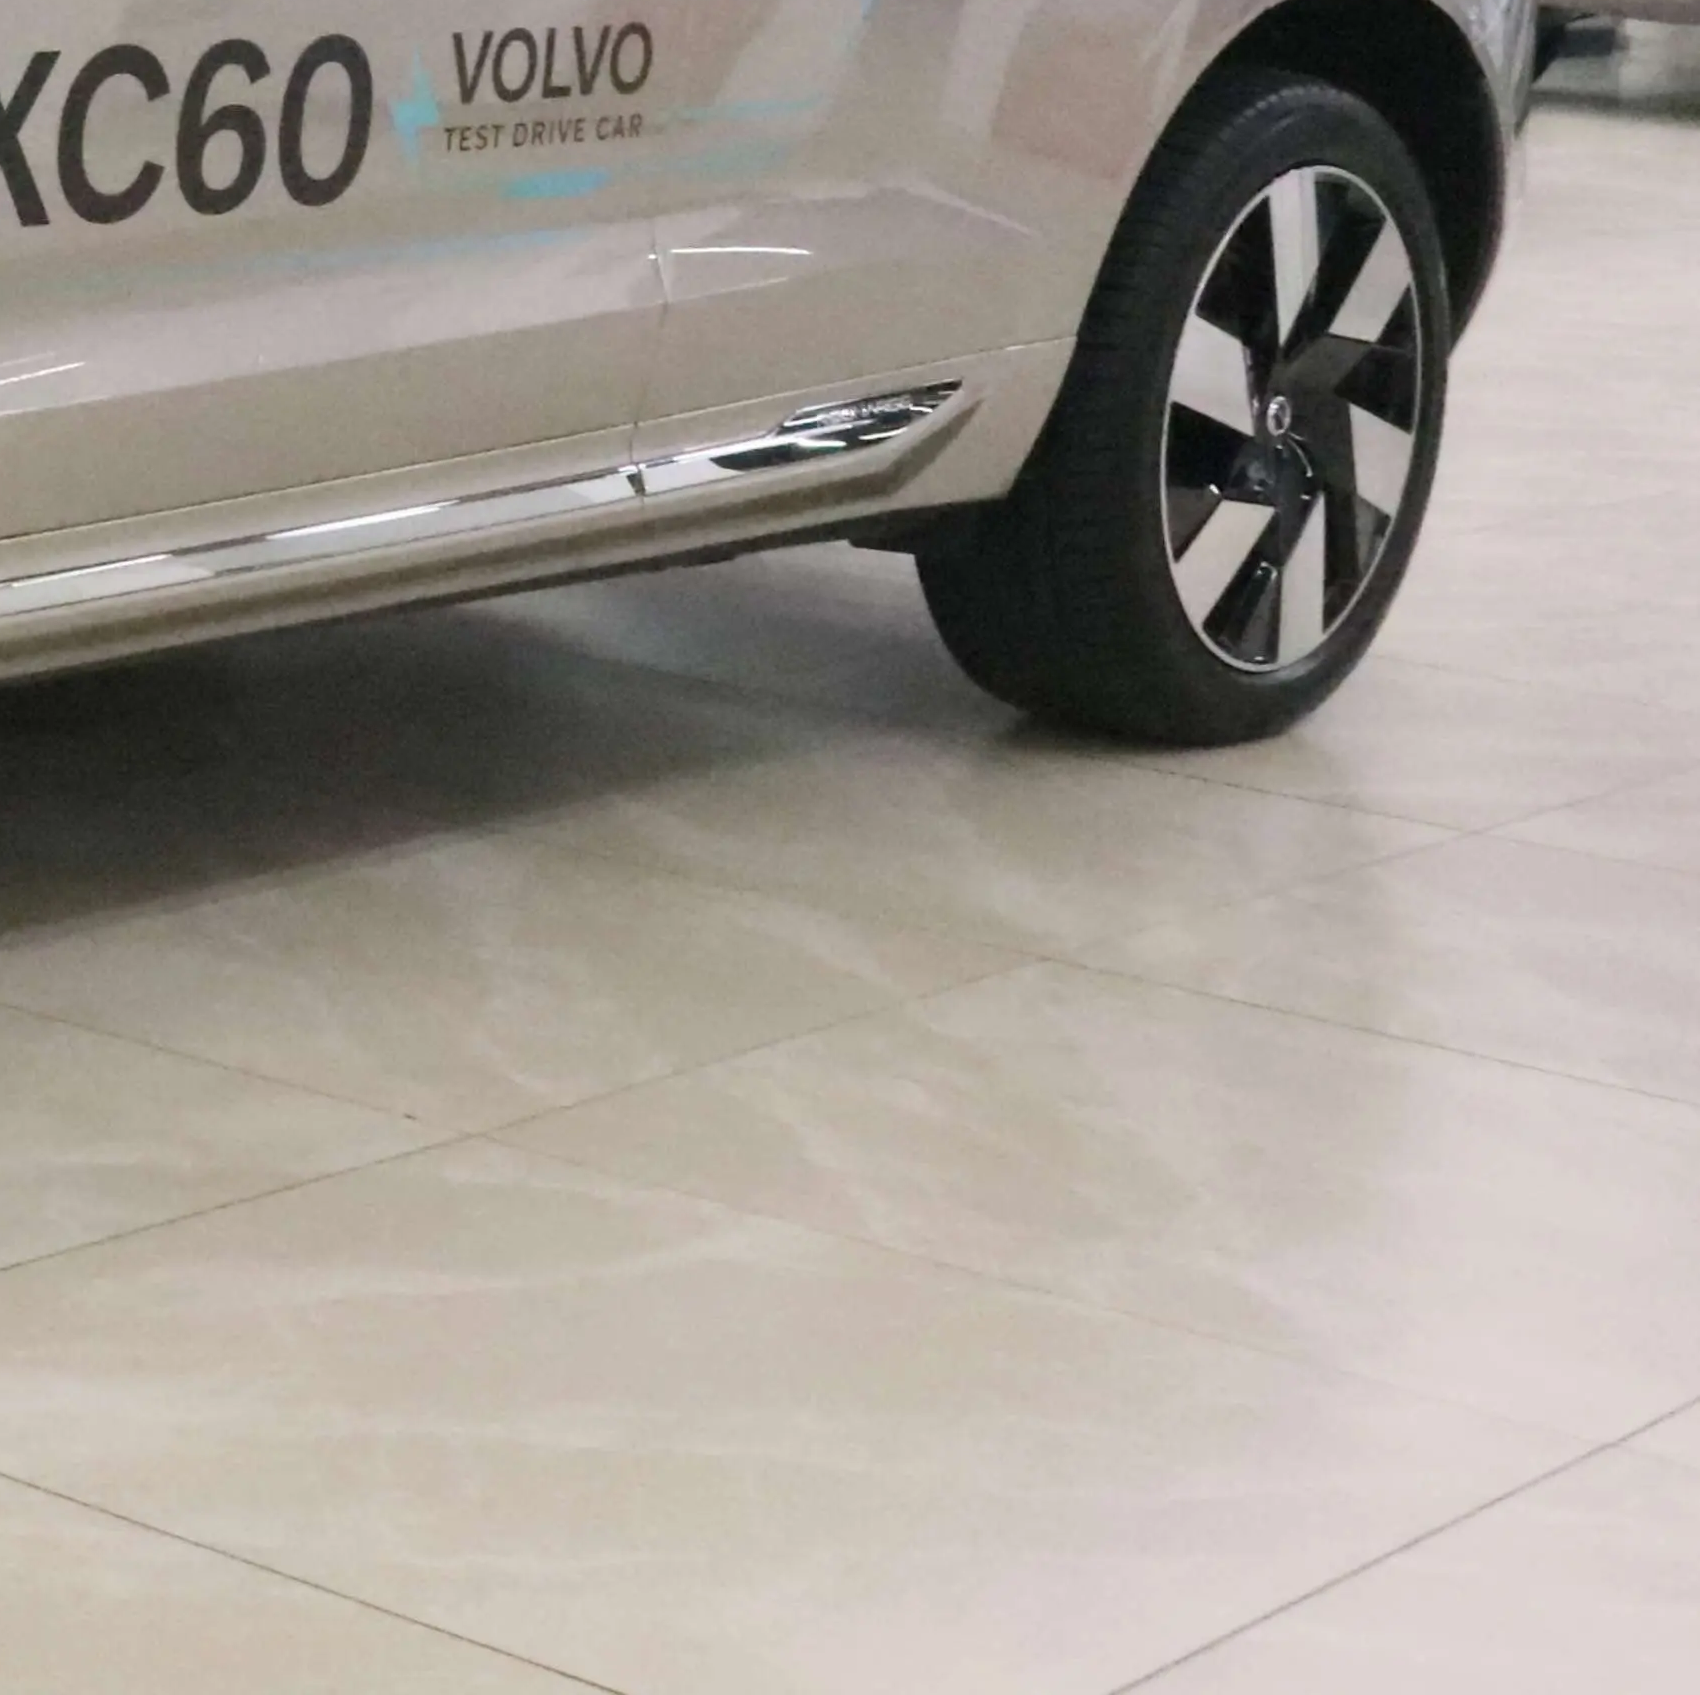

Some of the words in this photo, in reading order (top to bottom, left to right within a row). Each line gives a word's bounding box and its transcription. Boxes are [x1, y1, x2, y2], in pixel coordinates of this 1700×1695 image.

[452, 22, 653, 105] VOLVO
[444, 124, 505, 152] TEST
[512, 117, 586, 147] DRIVE
[595, 113, 643, 140] CAR
